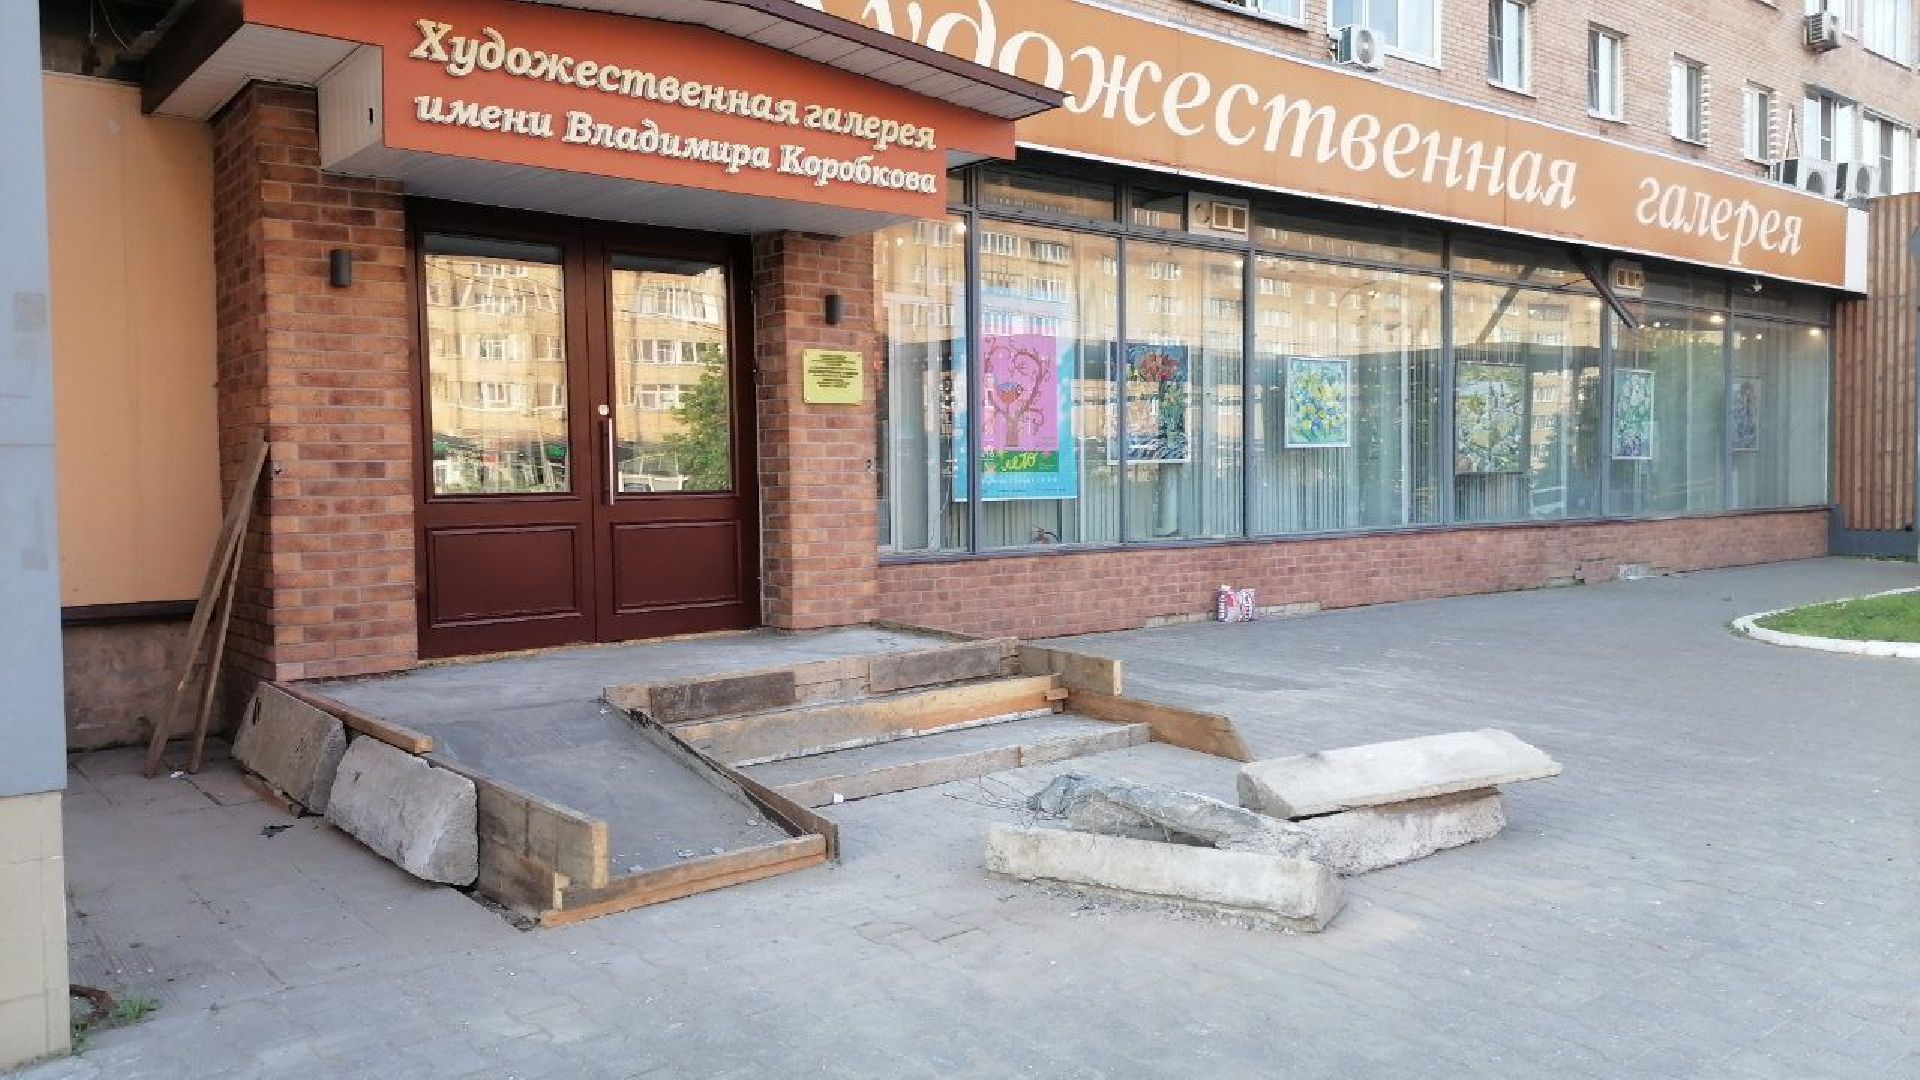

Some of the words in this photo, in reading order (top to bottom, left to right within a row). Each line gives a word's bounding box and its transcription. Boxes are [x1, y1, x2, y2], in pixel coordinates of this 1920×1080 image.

[410, 18, 799, 127] Художественная
[803, 104, 937, 151] галерея
[415, 95, 554, 139] имени
[562, 111, 772, 173] Владимира
[777, 145, 938, 194] Коробкова
[1636, 177, 1803, 264] галерея
